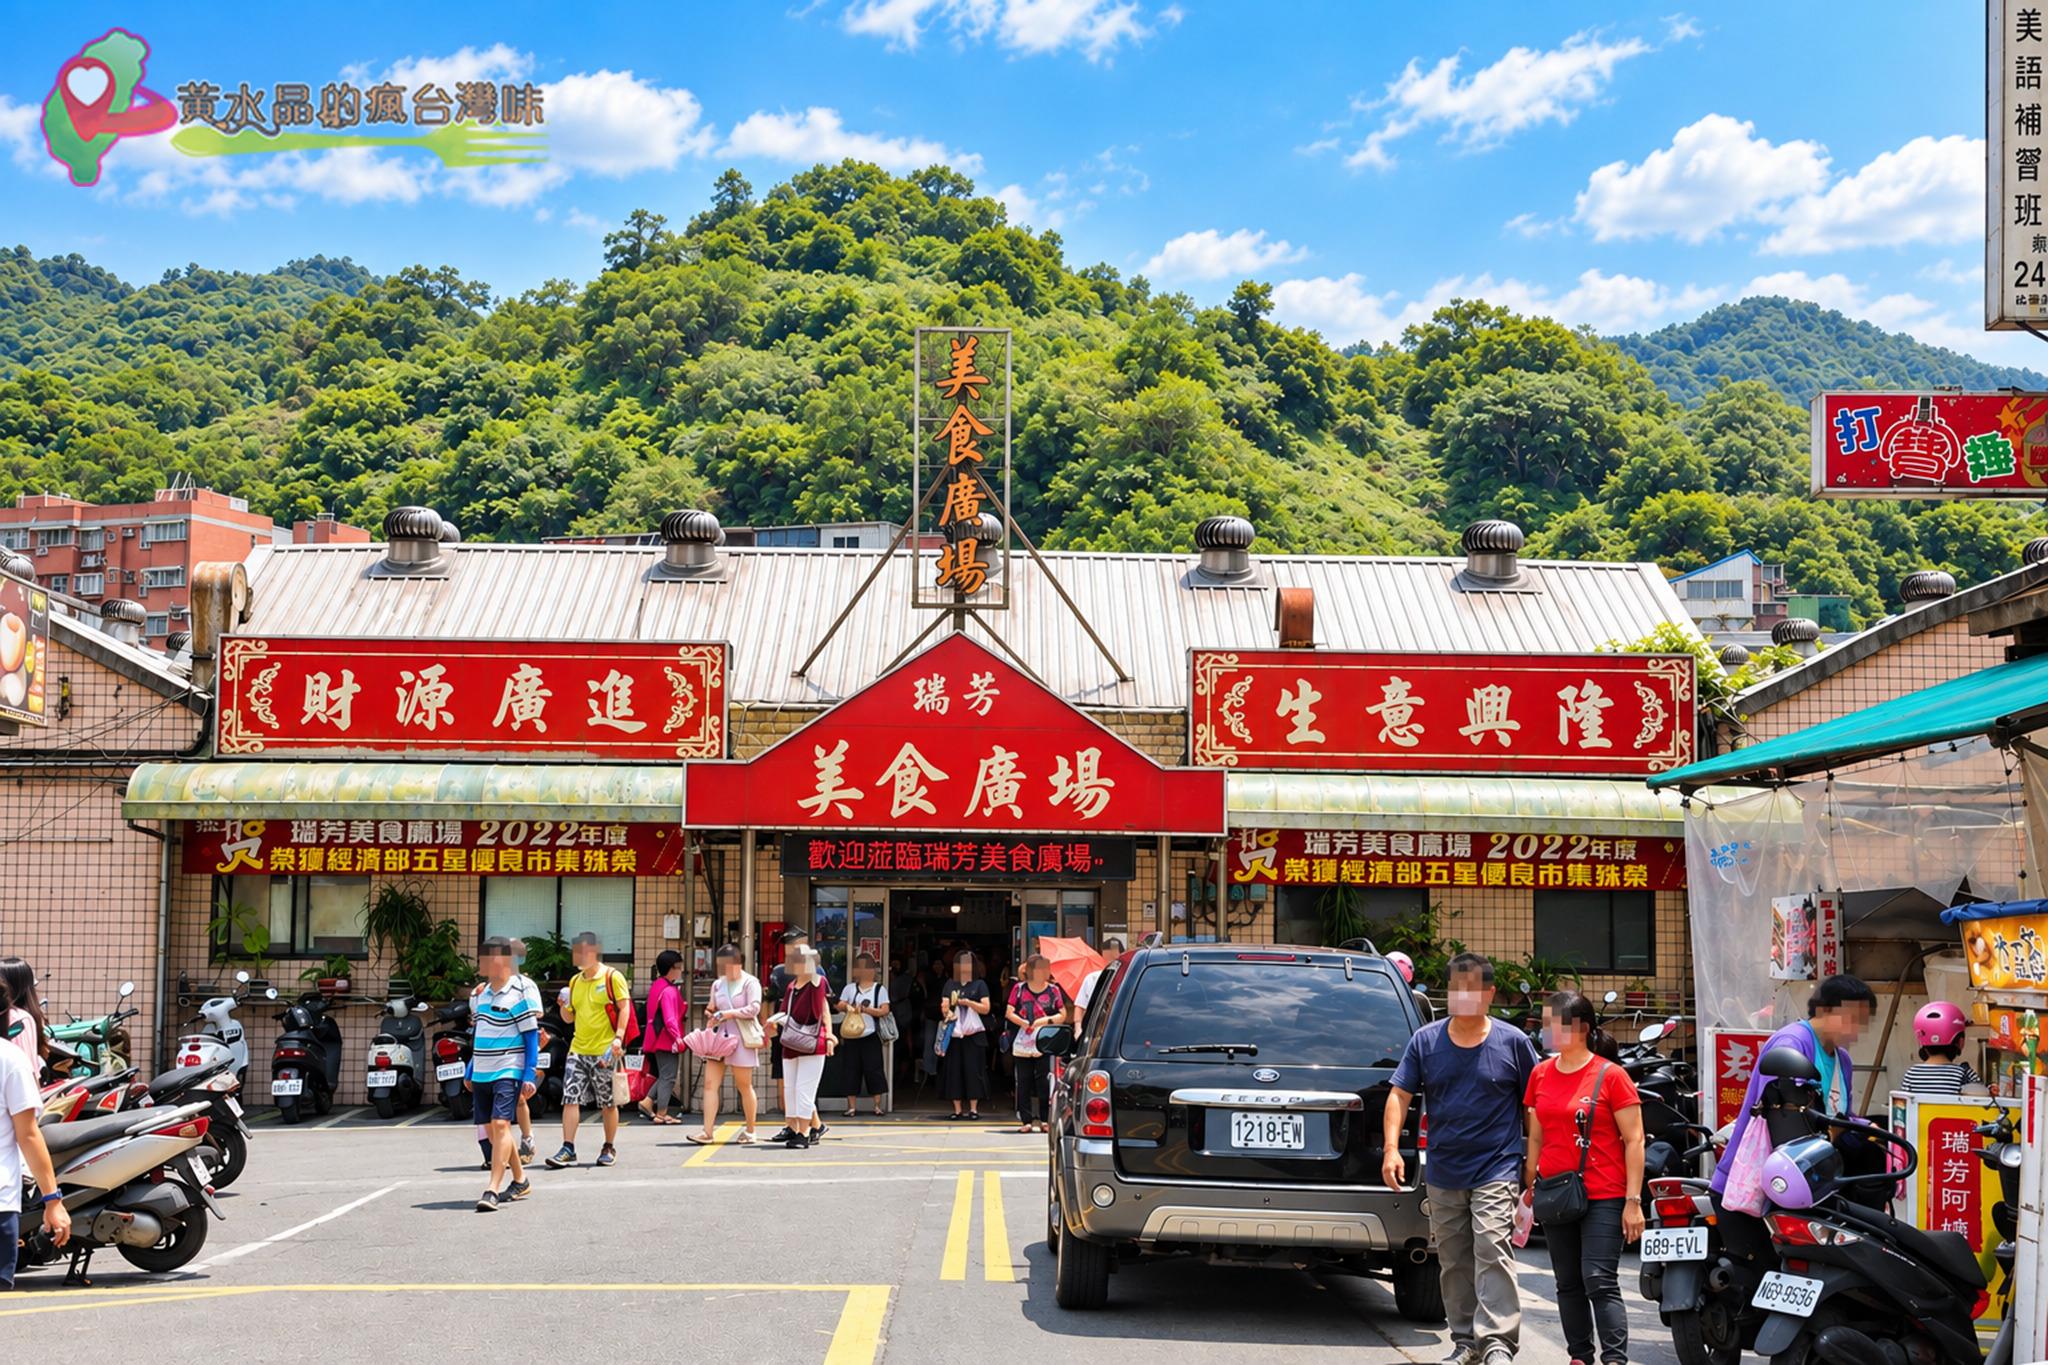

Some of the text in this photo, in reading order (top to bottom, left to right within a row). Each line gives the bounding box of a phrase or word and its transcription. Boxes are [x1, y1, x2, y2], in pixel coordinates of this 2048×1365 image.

[934, 335, 995, 595] 美食廣場
[301, 663, 648, 734] 財源廣進
[914, 672, 1001, 716] 瑞芳
[1275, 676, 1615, 749] 生意興隆
[797, 739, 1115, 820] 美食廣場
